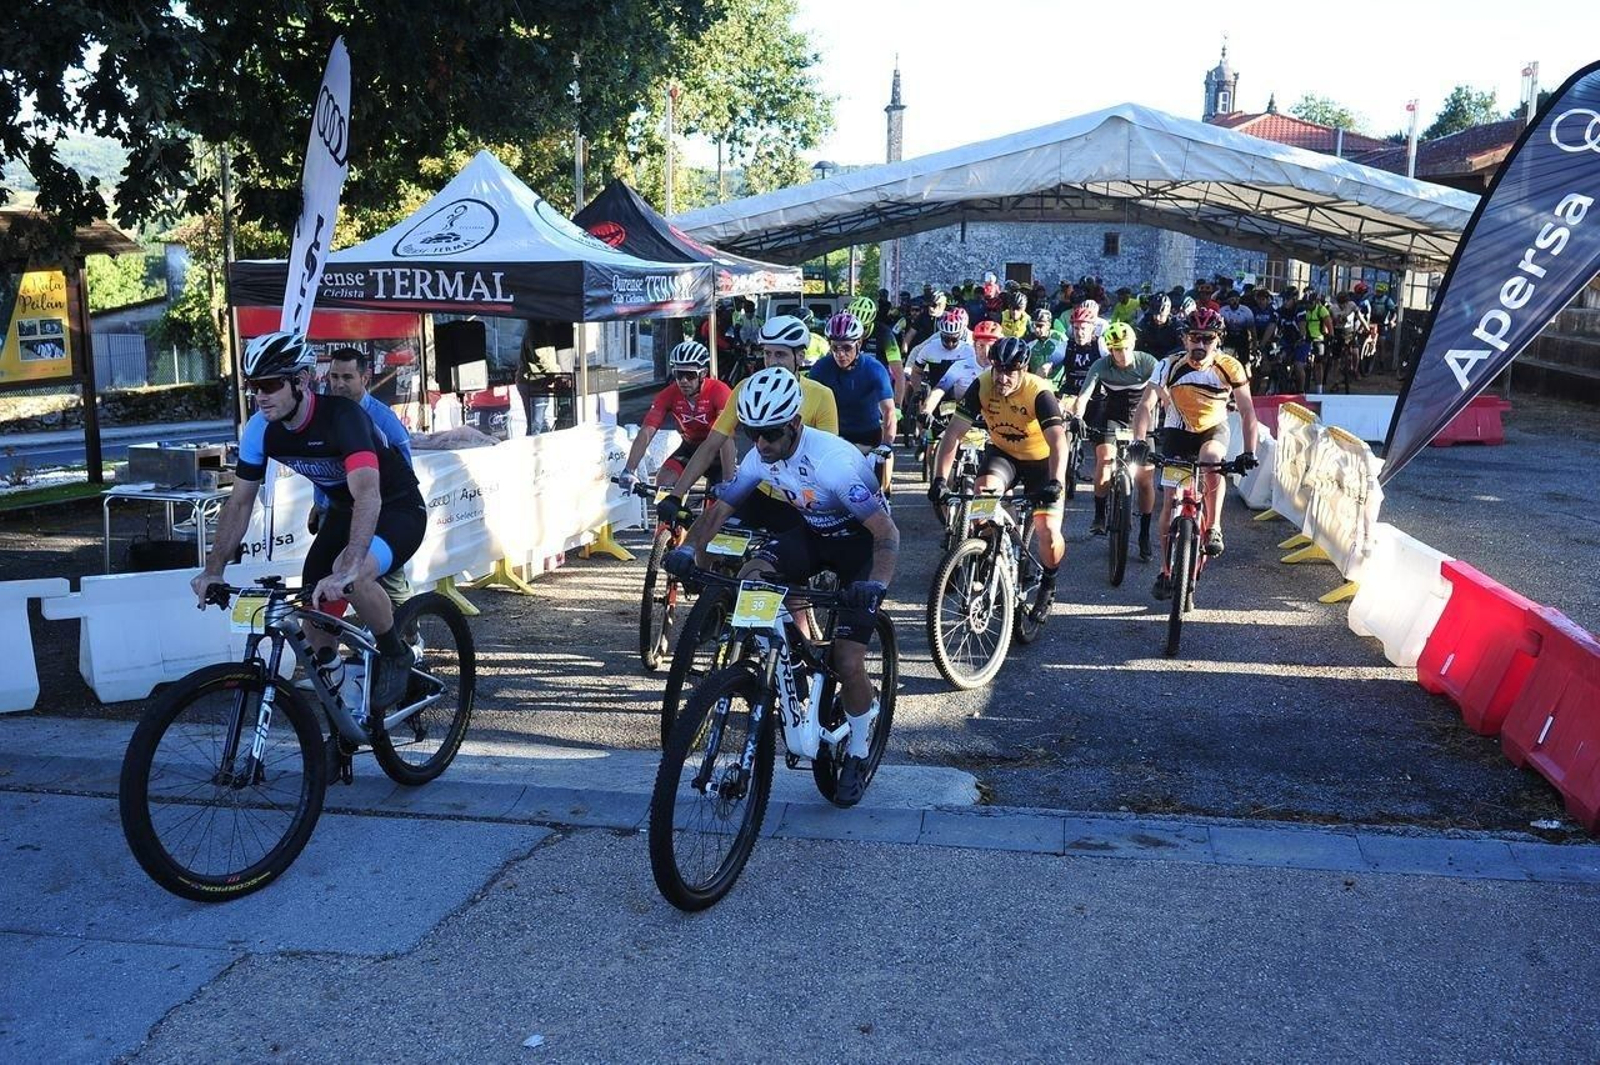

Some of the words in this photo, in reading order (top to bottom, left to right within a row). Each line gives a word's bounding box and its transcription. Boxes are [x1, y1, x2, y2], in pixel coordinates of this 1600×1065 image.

[318, 271, 365, 287] rense
[369, 268, 514, 302] TERMAL
[612, 274, 644, 292] Ourense
[323, 288, 365, 298] Ciclista
[1444, 193, 1594, 390] Apersa
[751, 601, 765, 611] 39
[780, 636, 801, 728] ORBEA
[201, 878, 259, 893] SCORPION
